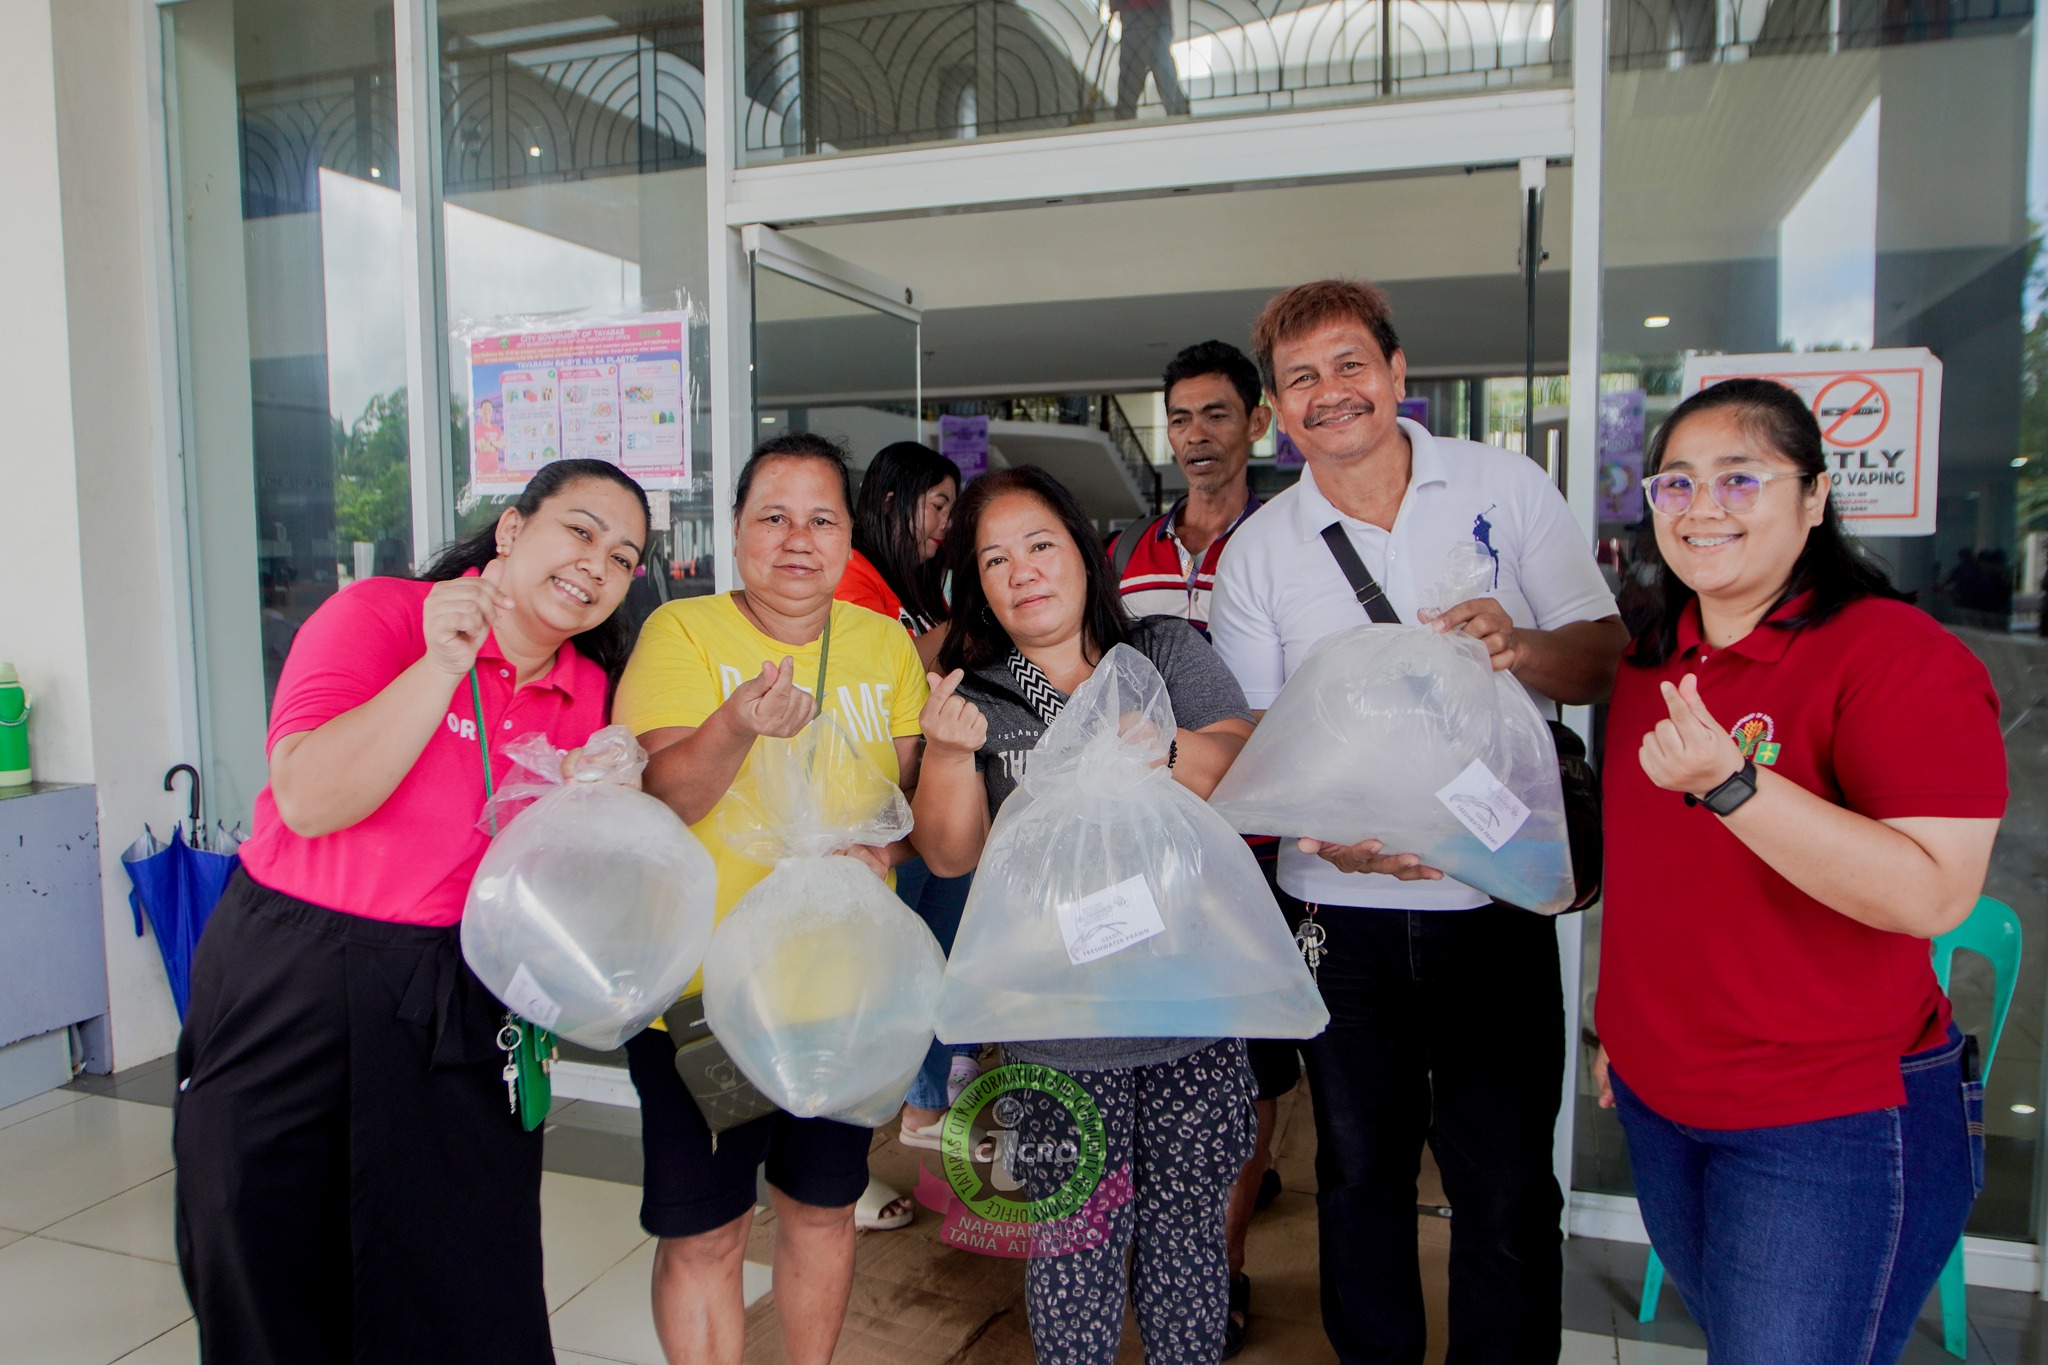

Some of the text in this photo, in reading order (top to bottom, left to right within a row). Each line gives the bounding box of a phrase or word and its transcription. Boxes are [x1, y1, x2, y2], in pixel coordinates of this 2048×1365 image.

[520, 335, 537, 343] CITY
[593, 328, 625, 337] TAYABAS
[1847, 471, 1906, 485] VAPING
[998, 728, 1039, 740] ISLAND
[1083, 928, 1150, 956] FRESHWATER PRAWN
